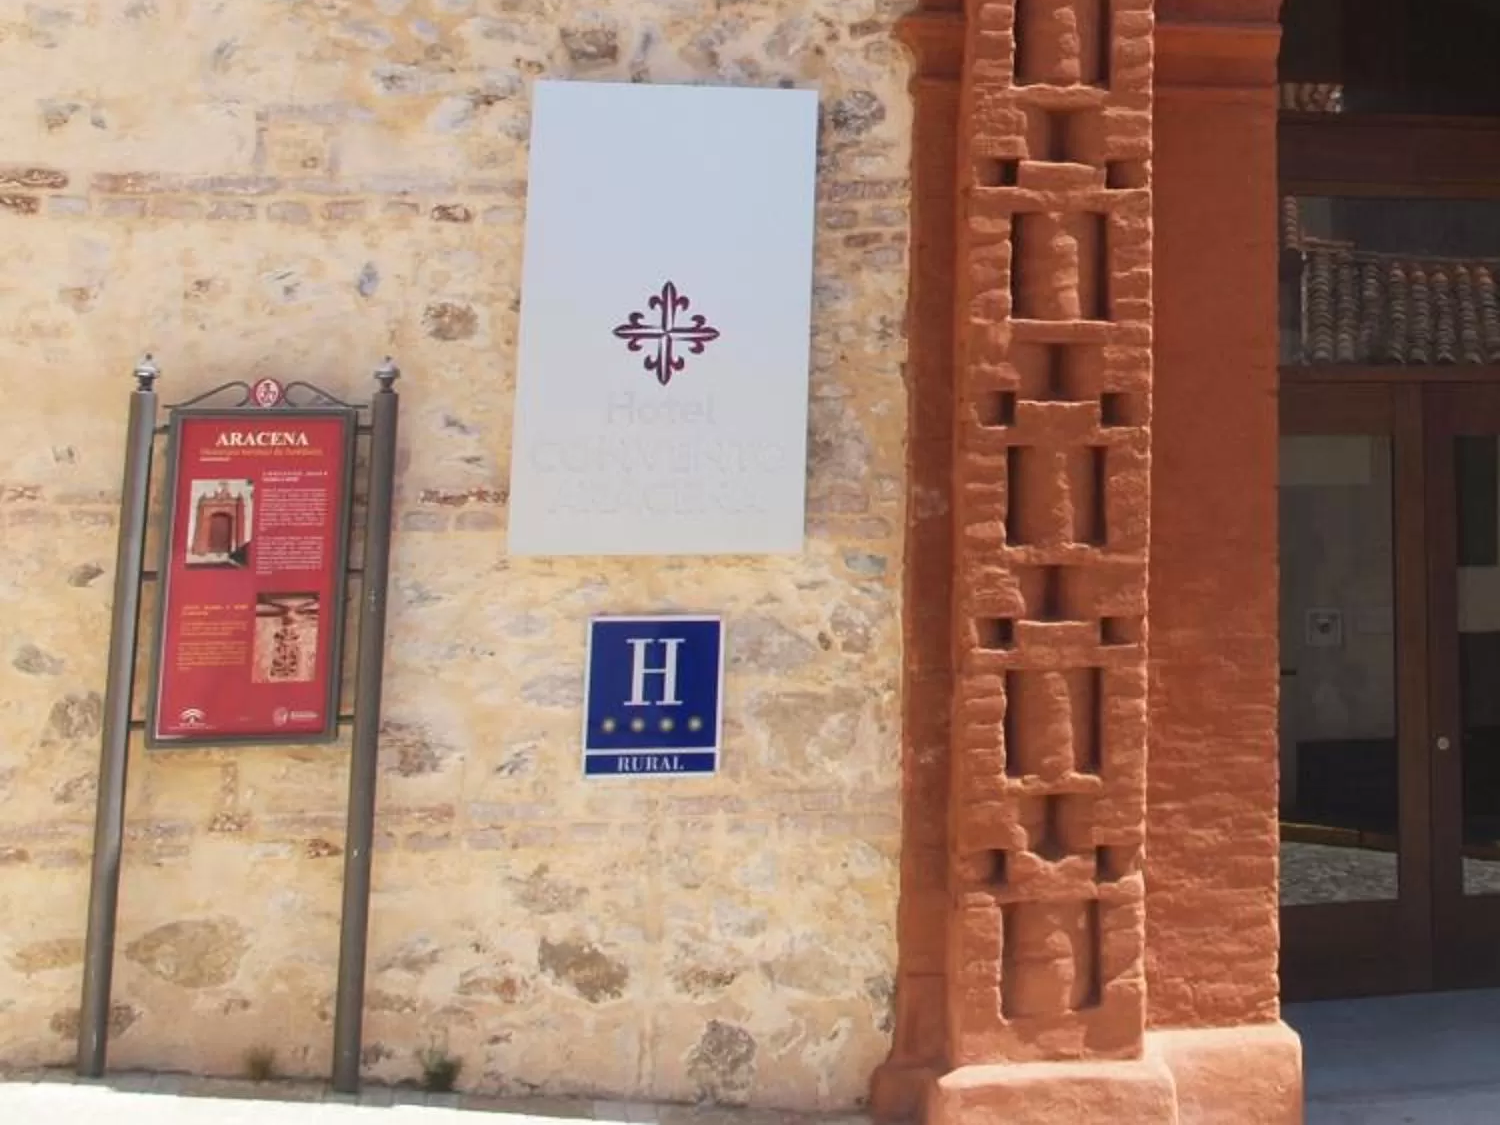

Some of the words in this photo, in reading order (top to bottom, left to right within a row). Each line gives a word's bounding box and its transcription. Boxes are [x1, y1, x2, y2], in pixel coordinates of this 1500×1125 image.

[606, 390, 717, 424] Hotel
[215, 431, 309, 447] ARACENA
[624, 638, 686, 706] H
[617, 756, 685, 772] RURAL
